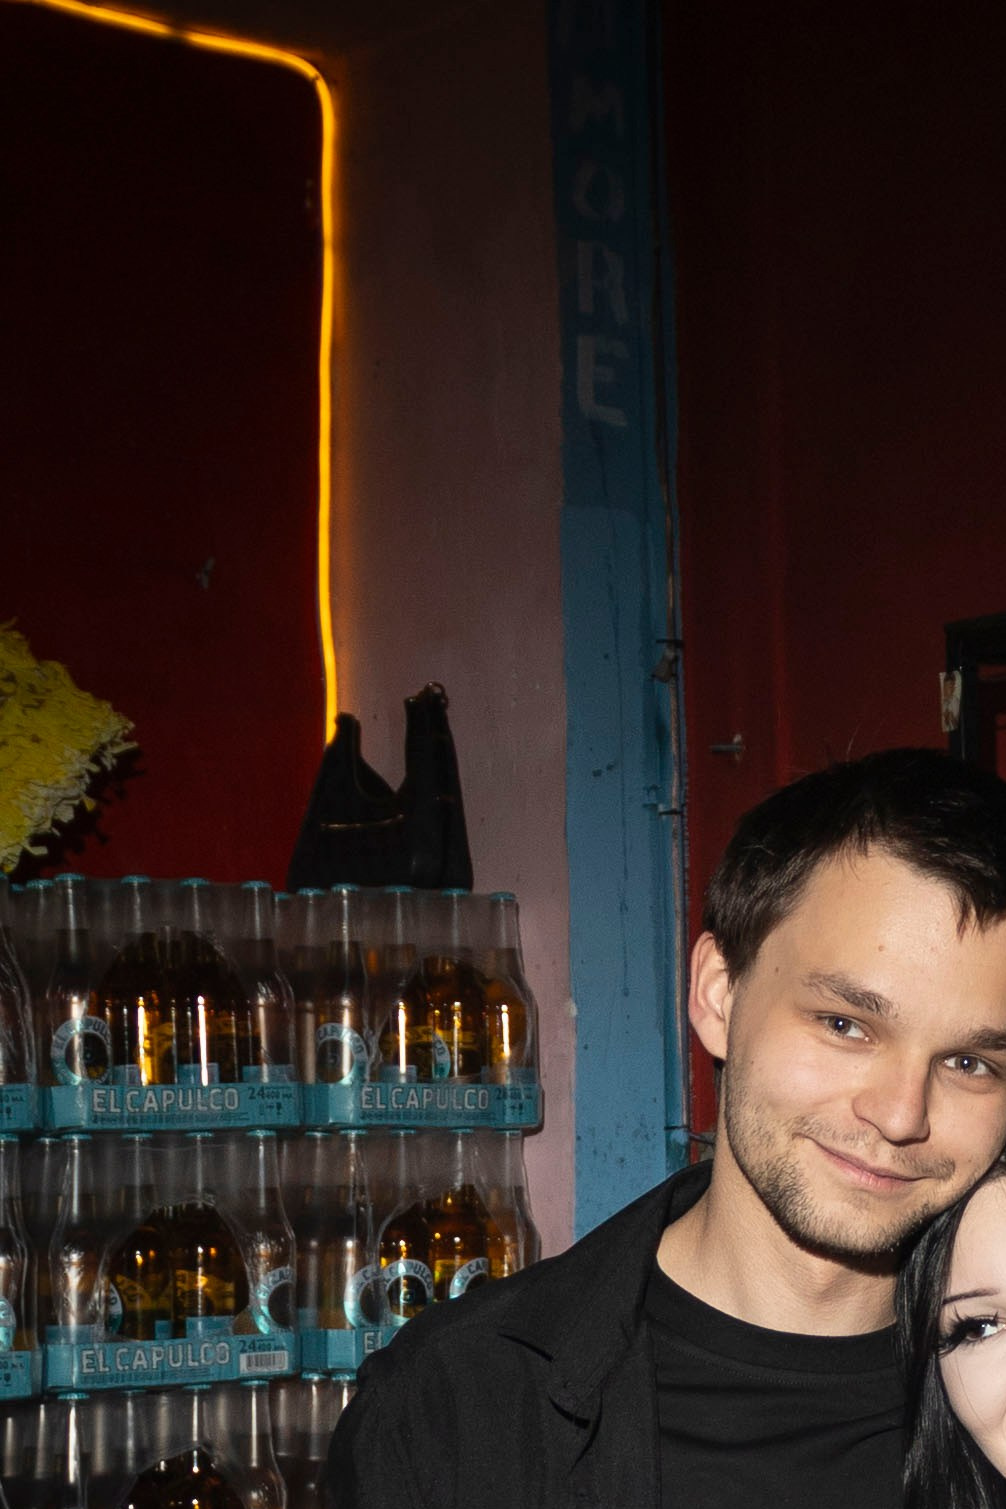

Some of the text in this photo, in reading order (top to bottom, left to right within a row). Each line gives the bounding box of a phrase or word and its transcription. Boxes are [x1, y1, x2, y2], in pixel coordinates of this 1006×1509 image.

[92, 1087, 240, 1113] EL CAPULCO
[361, 1087, 489, 1109] EL CAPULCO
[81, 1341, 231, 1374] EL CAPULCO
